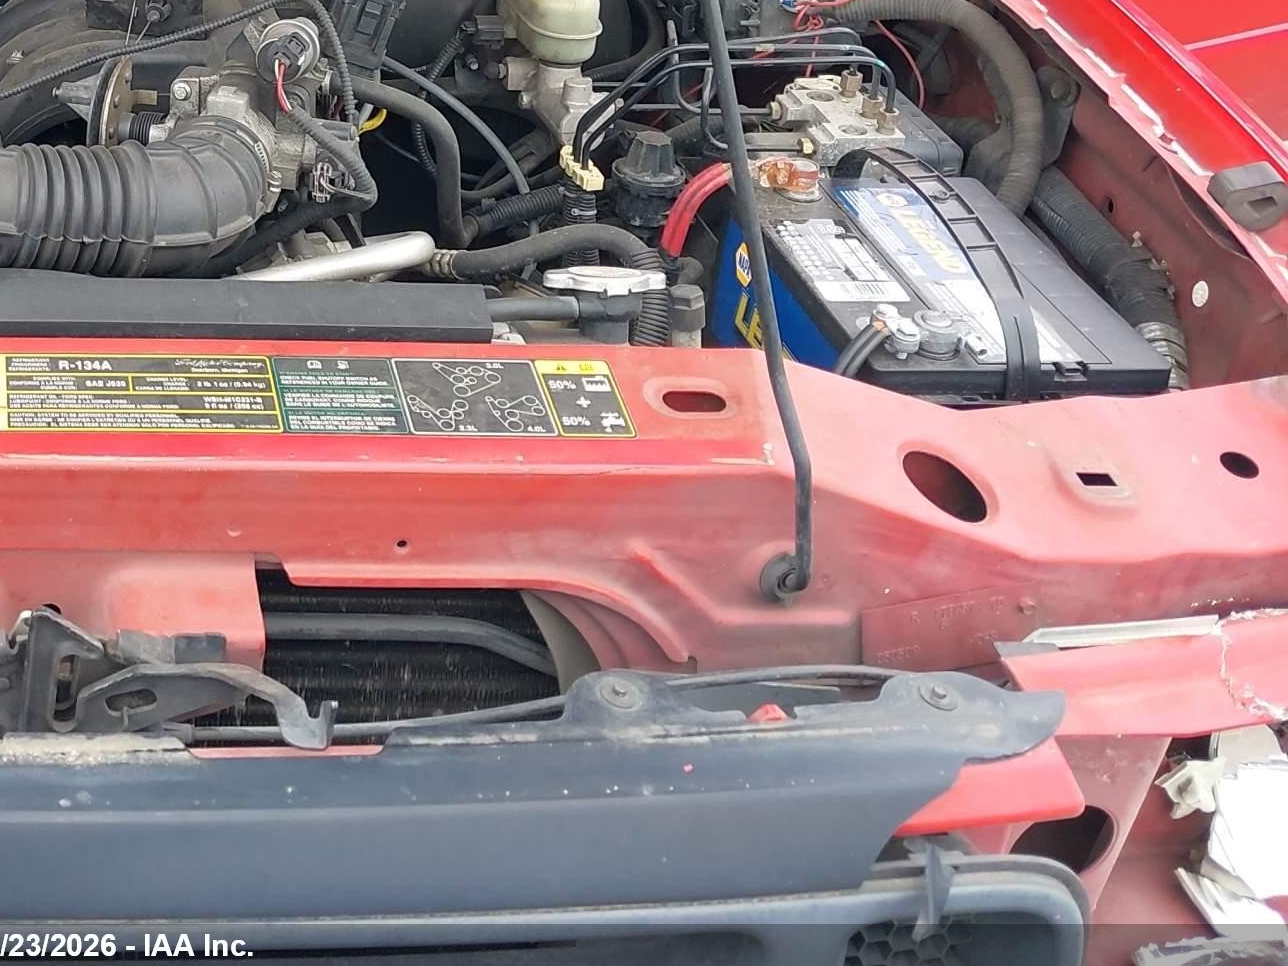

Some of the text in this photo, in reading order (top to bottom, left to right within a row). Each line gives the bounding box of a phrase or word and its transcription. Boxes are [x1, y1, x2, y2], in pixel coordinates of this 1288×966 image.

[58, 360, 112, 371] R-134A
[549, 380, 576, 389] 50%
[562, 417, 591, 426] 50%
